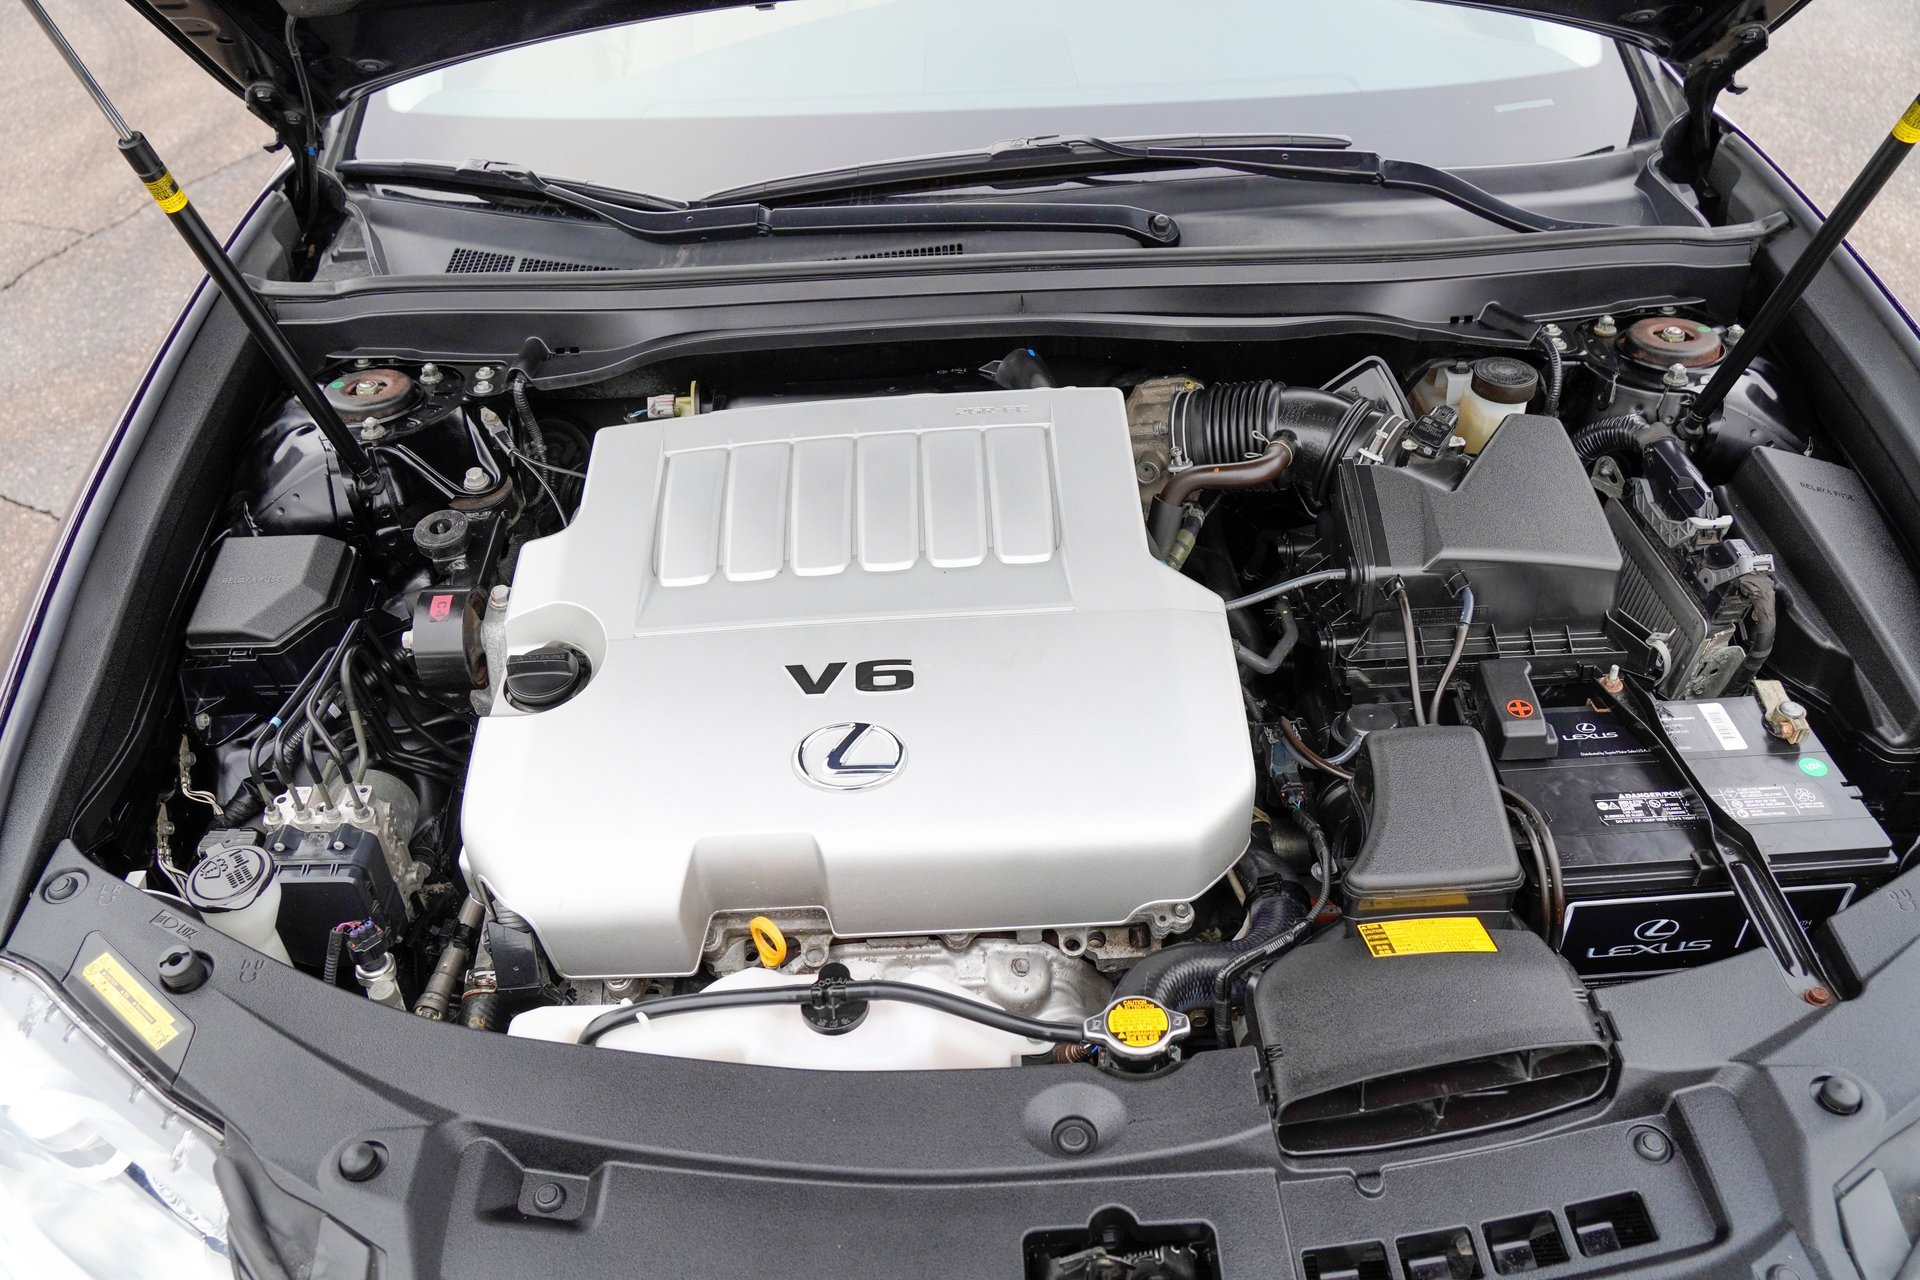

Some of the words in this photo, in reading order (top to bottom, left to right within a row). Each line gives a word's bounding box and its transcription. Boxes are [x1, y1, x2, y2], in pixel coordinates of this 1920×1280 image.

[222, 576, 250, 585] RELAY
[784, 659, 914, 695] V6
[1562, 731, 1619, 741] LEXUS
[1586, 939, 1713, 959] LEXUS
